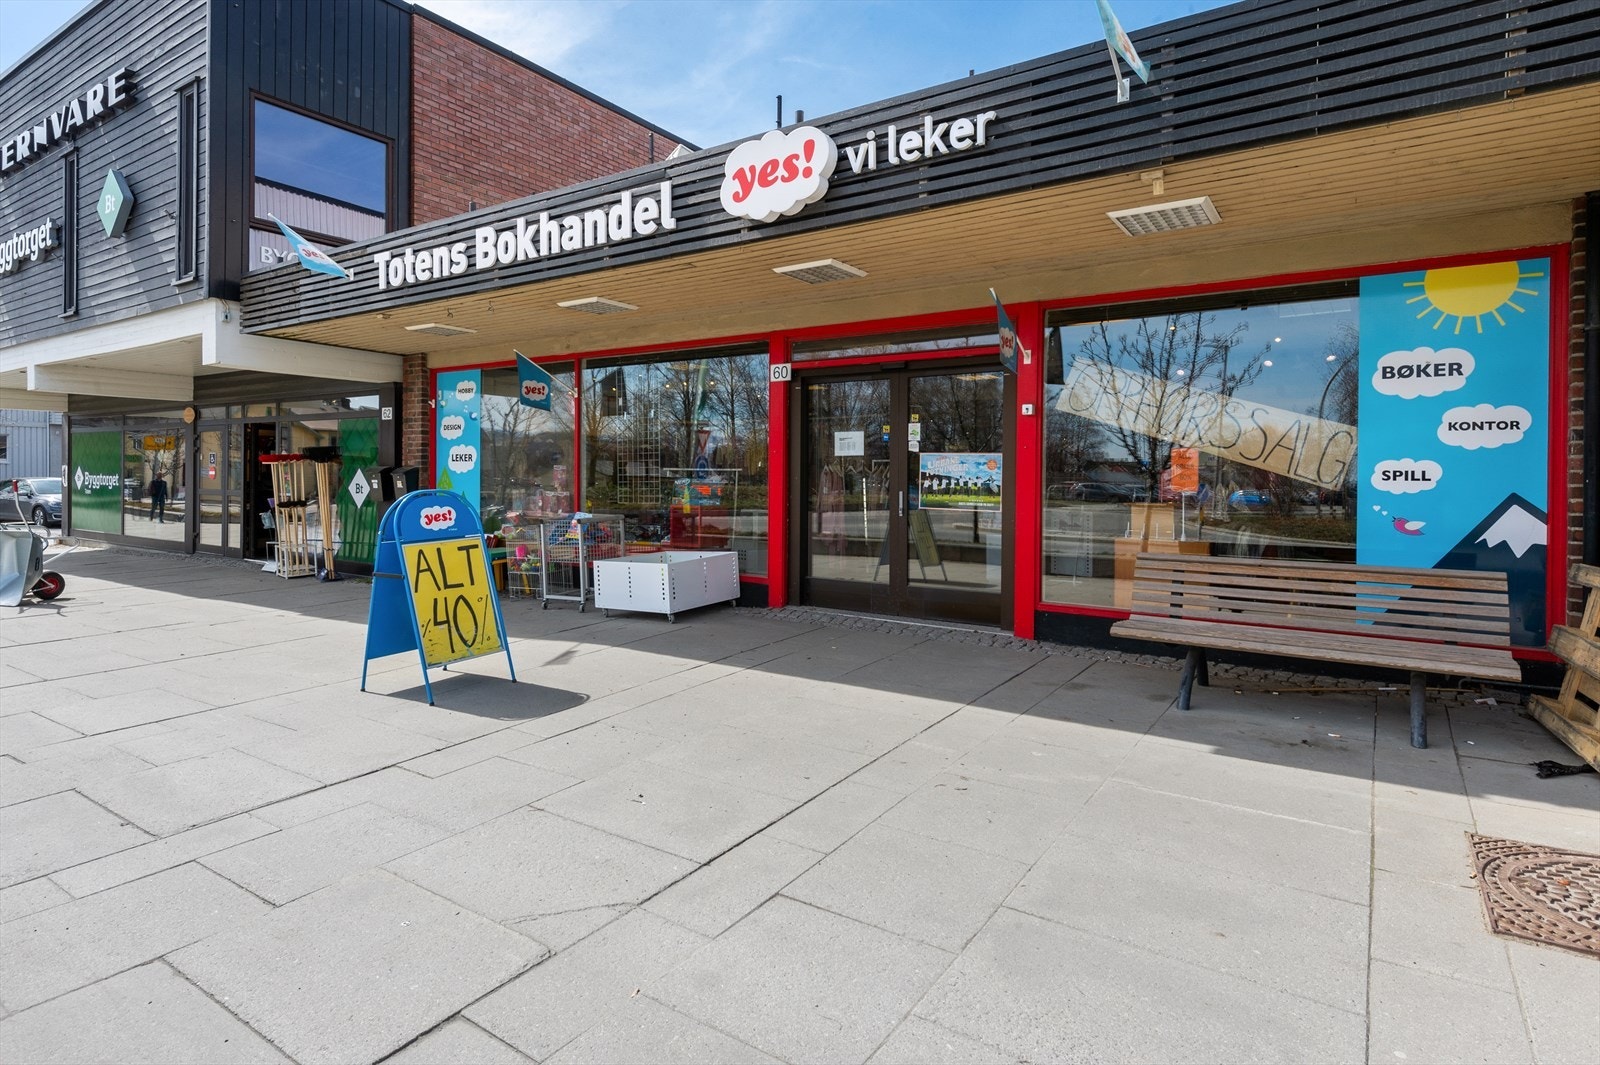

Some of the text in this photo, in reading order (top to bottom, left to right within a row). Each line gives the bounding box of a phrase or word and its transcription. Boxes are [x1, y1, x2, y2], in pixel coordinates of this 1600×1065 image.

[1, 67, 126, 171] ERNVARE
[846, 110, 997, 174] vi leker
[732, 138, 816, 204] yes!
[105, 194, 116, 214] Bt
[373, 181, 677, 290] Totens Bokhandel
[772, 366, 788, 379] 60
[1381, 362, 1464, 380] BØKER
[524, 385, 546, 396] yes!
[383, 408, 392, 419] 62
[1447, 420, 1521, 432] KONTOR
[451, 453, 473, 462] LEKER
[84, 471, 119, 490] Byggtorget
[1381, 470, 1432, 482] SPILL
[355, 483, 364, 494] Bt
[424, 509, 453, 526] yes!
[414, 544, 479, 593] ALT
